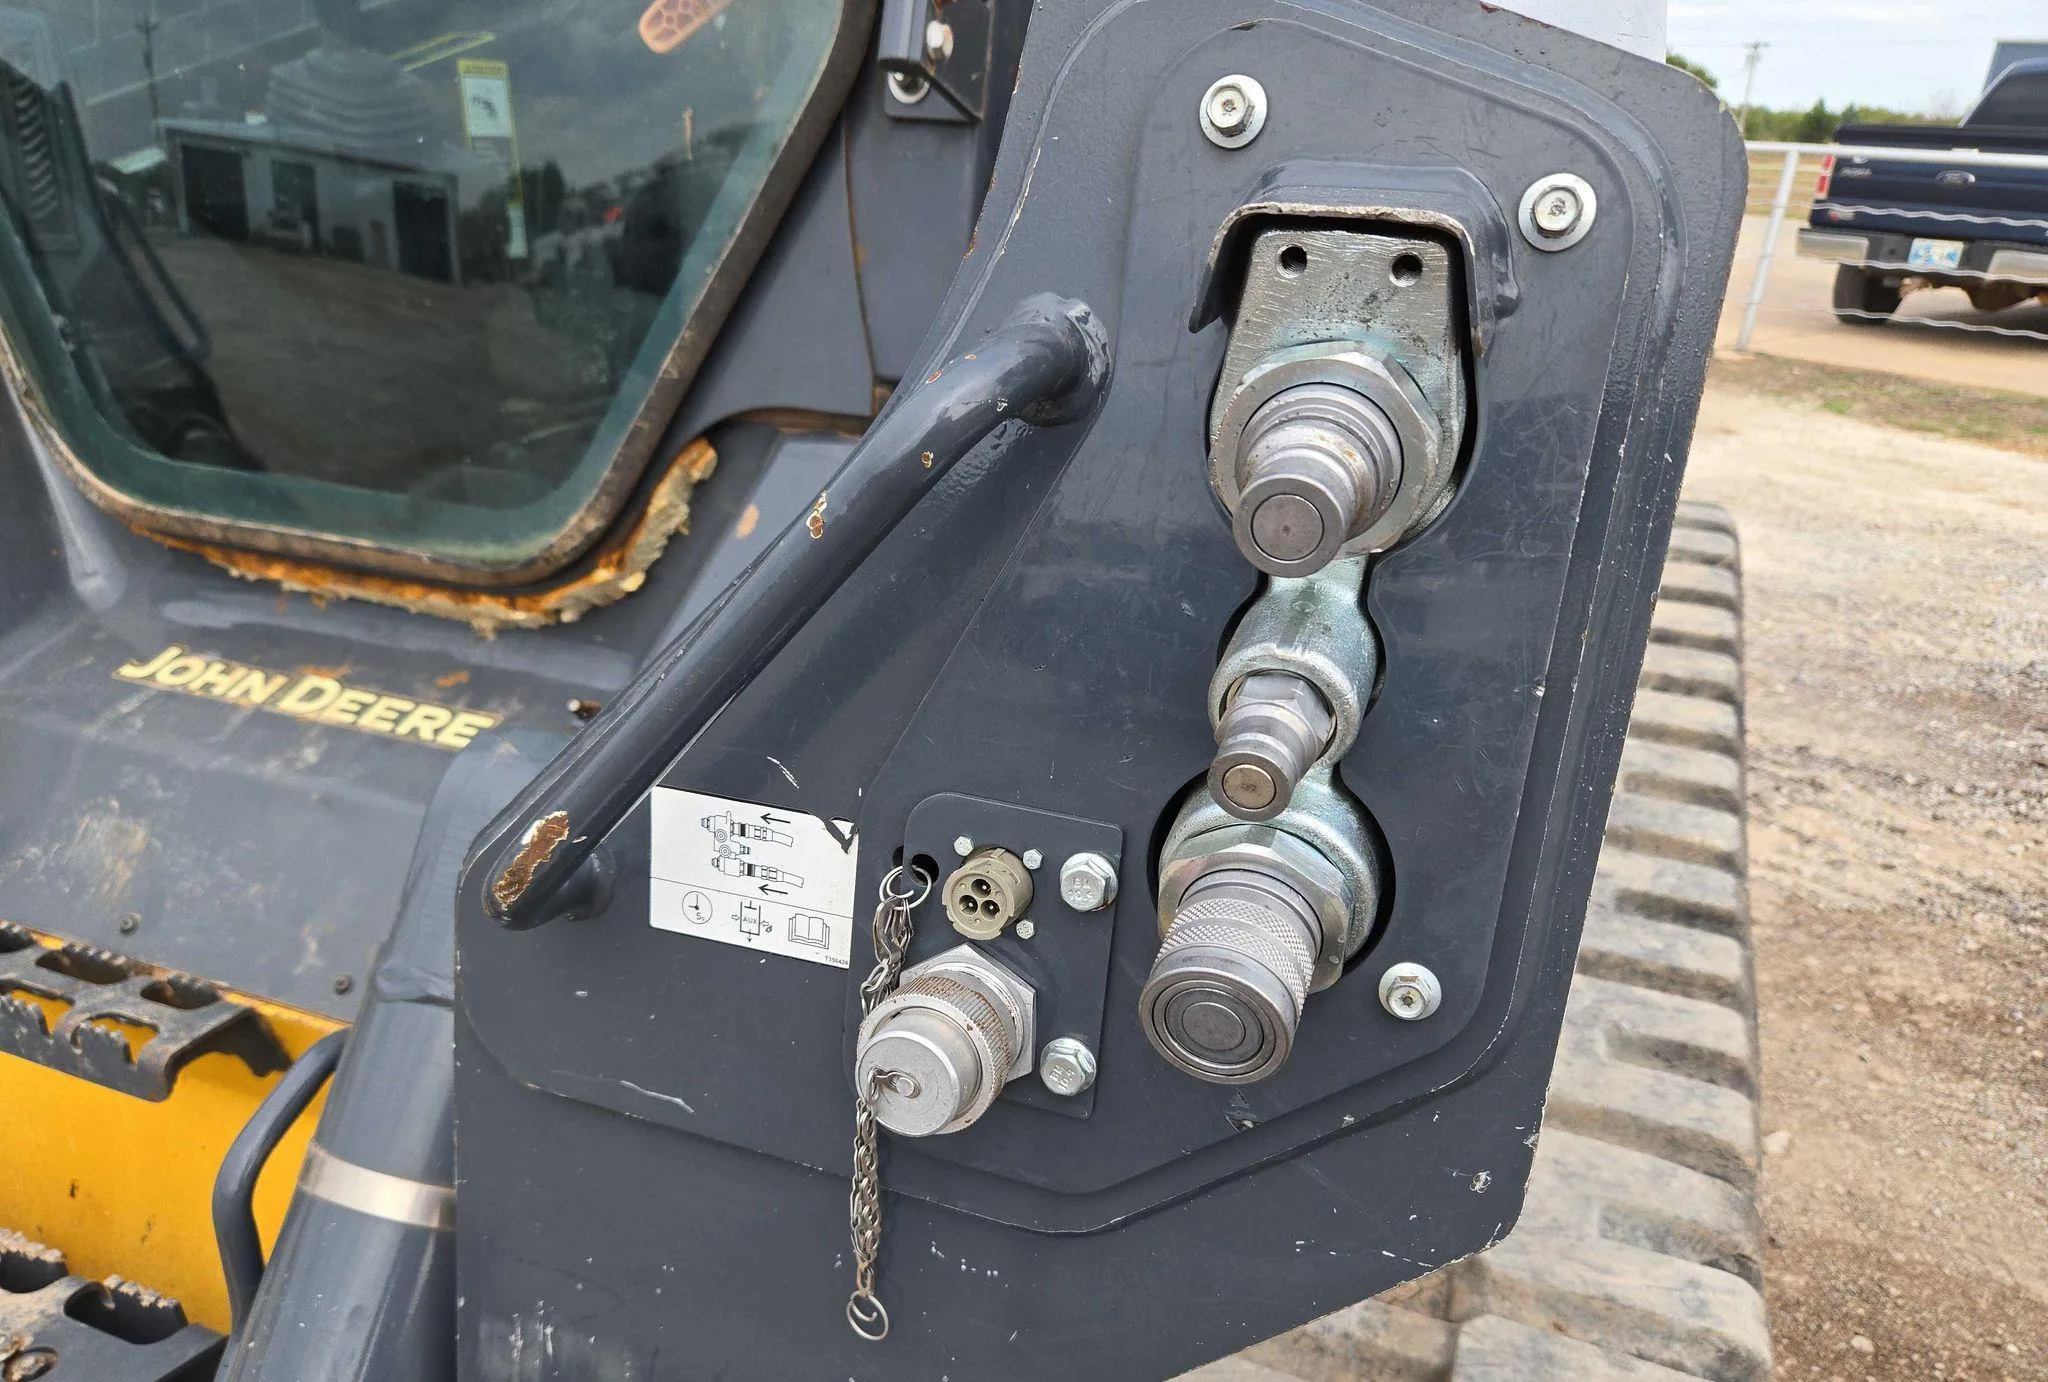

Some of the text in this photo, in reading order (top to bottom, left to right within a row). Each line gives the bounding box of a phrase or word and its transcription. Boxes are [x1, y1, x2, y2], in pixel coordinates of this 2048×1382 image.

[116, 645, 496, 749] JOHN DEERE
[743, 916, 758, 925] AUX
